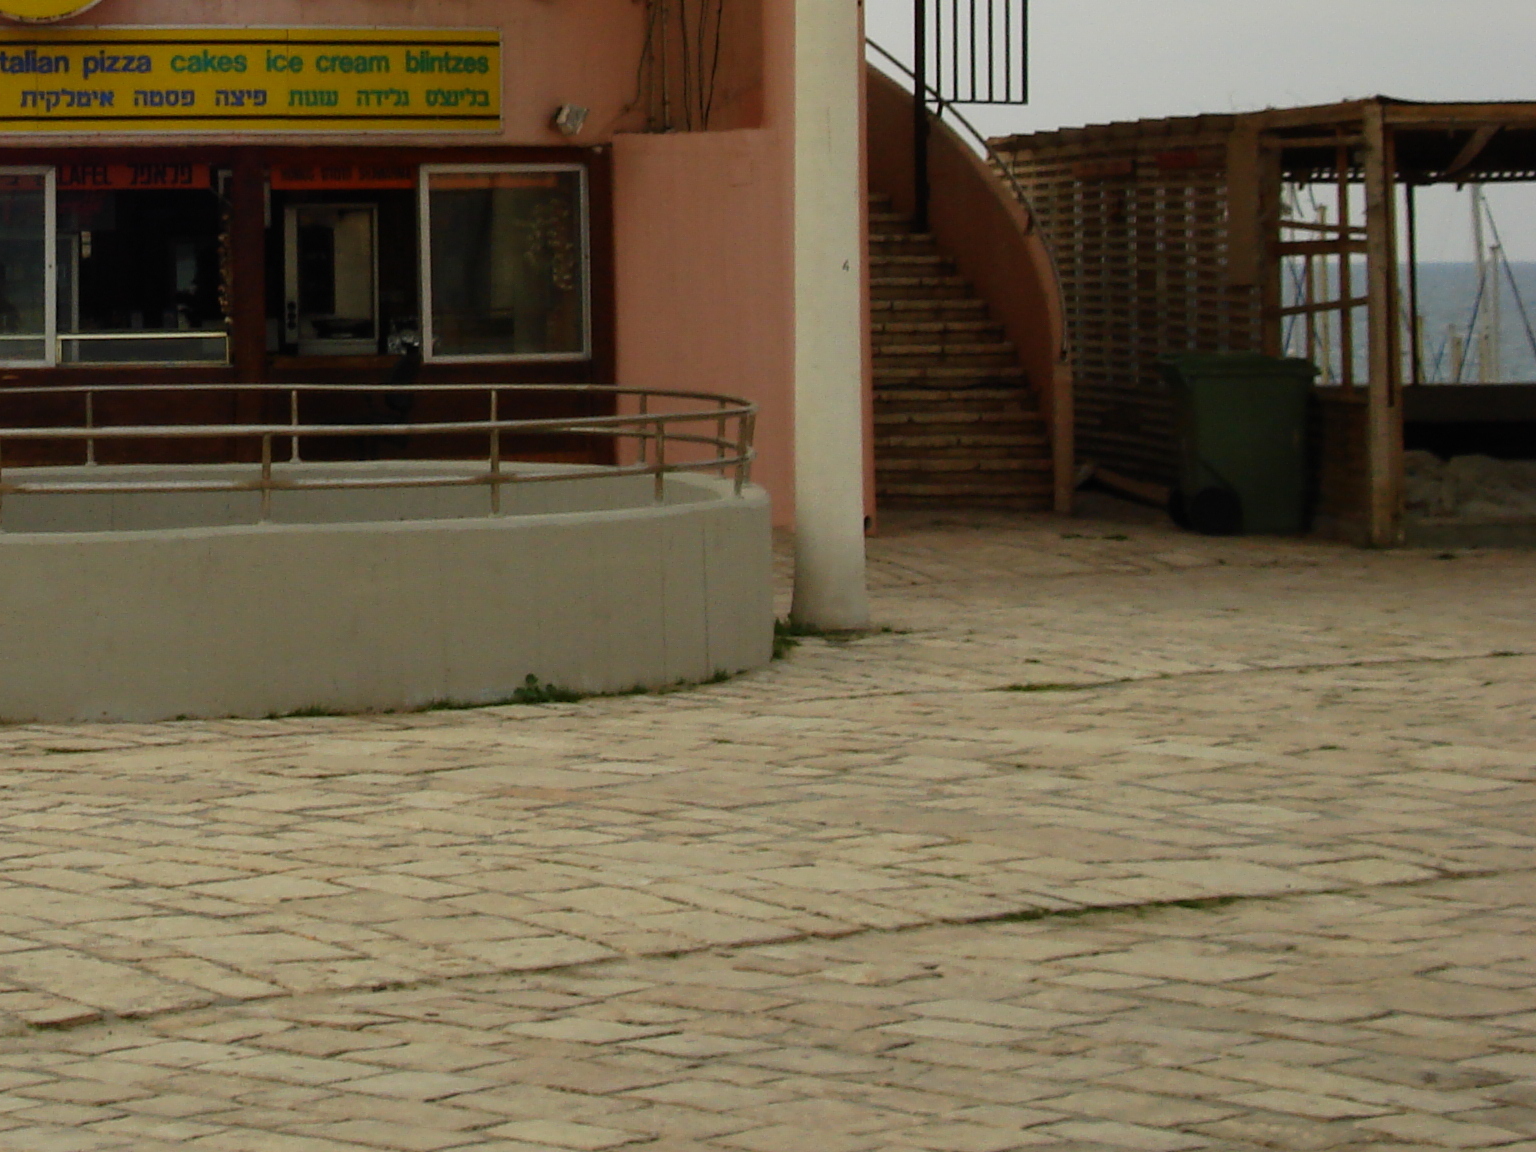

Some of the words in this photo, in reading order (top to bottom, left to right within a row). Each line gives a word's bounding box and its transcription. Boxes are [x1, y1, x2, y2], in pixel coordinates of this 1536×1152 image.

[82, 50, 152, 79] pizza
[170, 50, 248, 73] cakes
[266, 50, 304, 73] ice
[315, 54, 391, 74] cream
[405, 50, 490, 74] blintzes
[20, 88, 115, 113] איטלקית
[133, 89, 196, 107] פסטה
[215, 88, 268, 107] פיצה
[356, 88, 410, 107] גלידה
